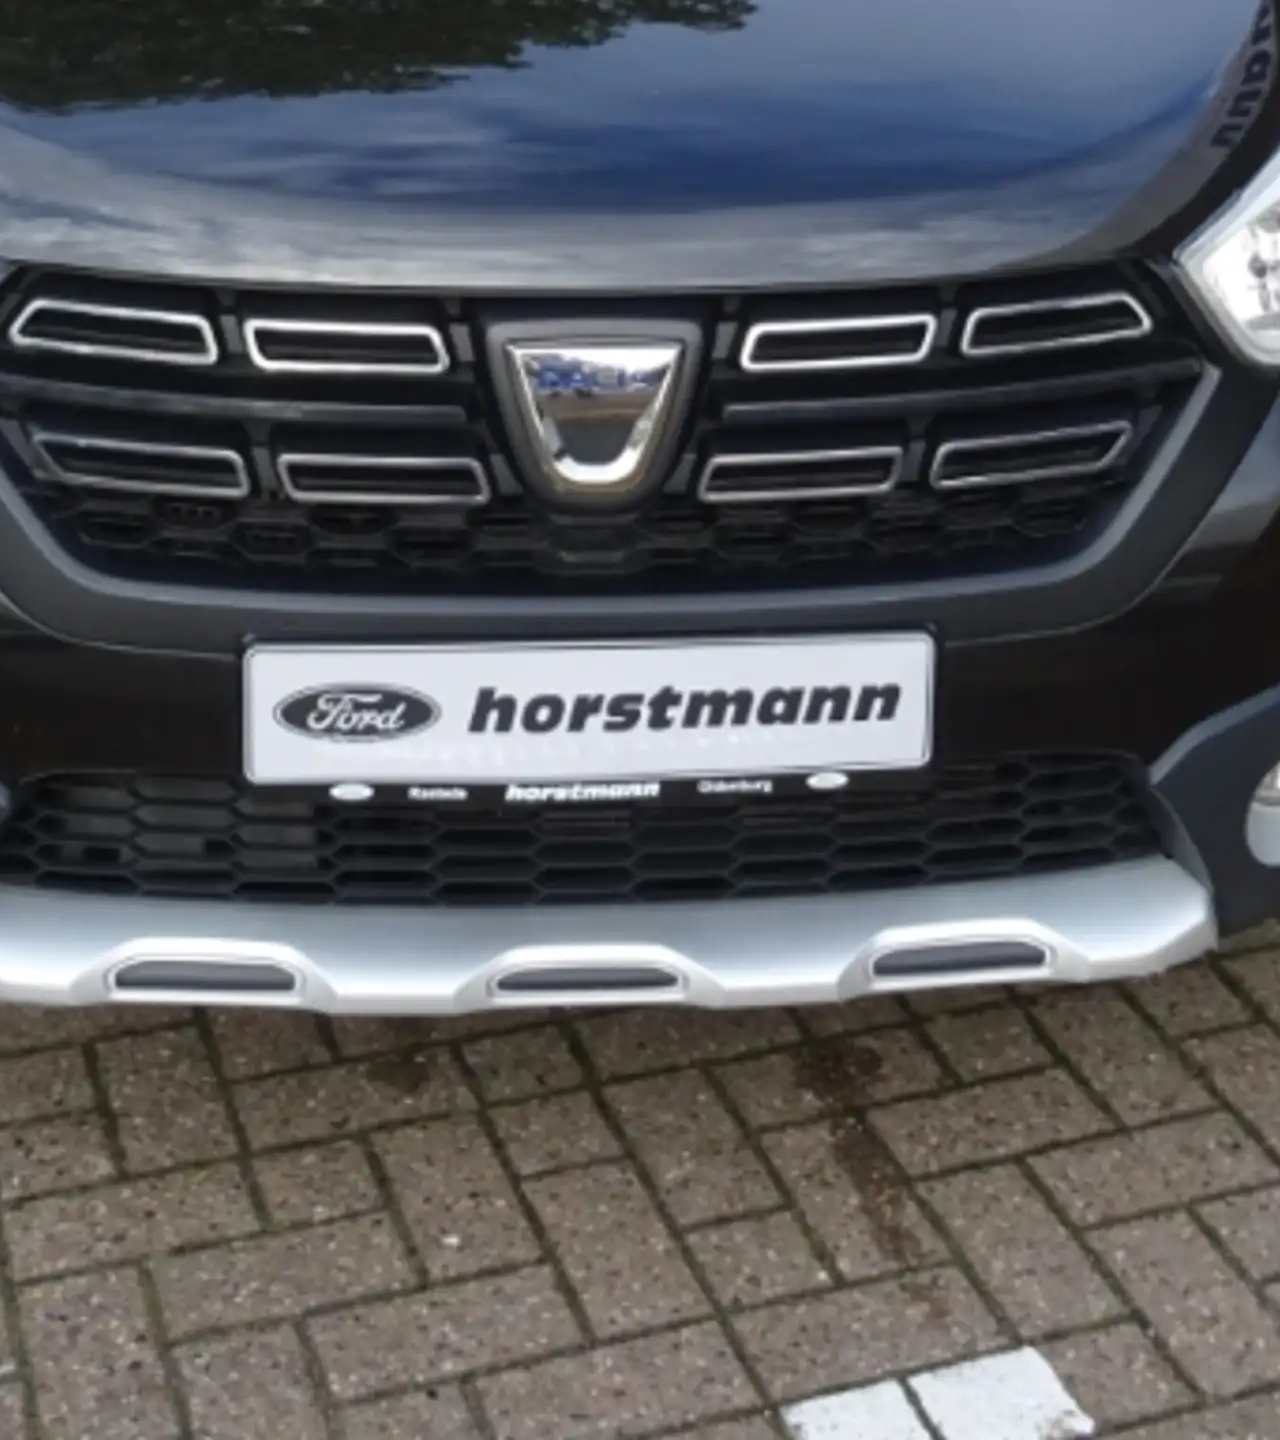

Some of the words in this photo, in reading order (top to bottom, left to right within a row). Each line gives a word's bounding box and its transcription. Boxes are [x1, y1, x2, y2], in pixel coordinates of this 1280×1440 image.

[305, 692, 408, 732] Ford
[467, 681, 903, 735] horstmann
[505, 781, 660, 802] horstmann
